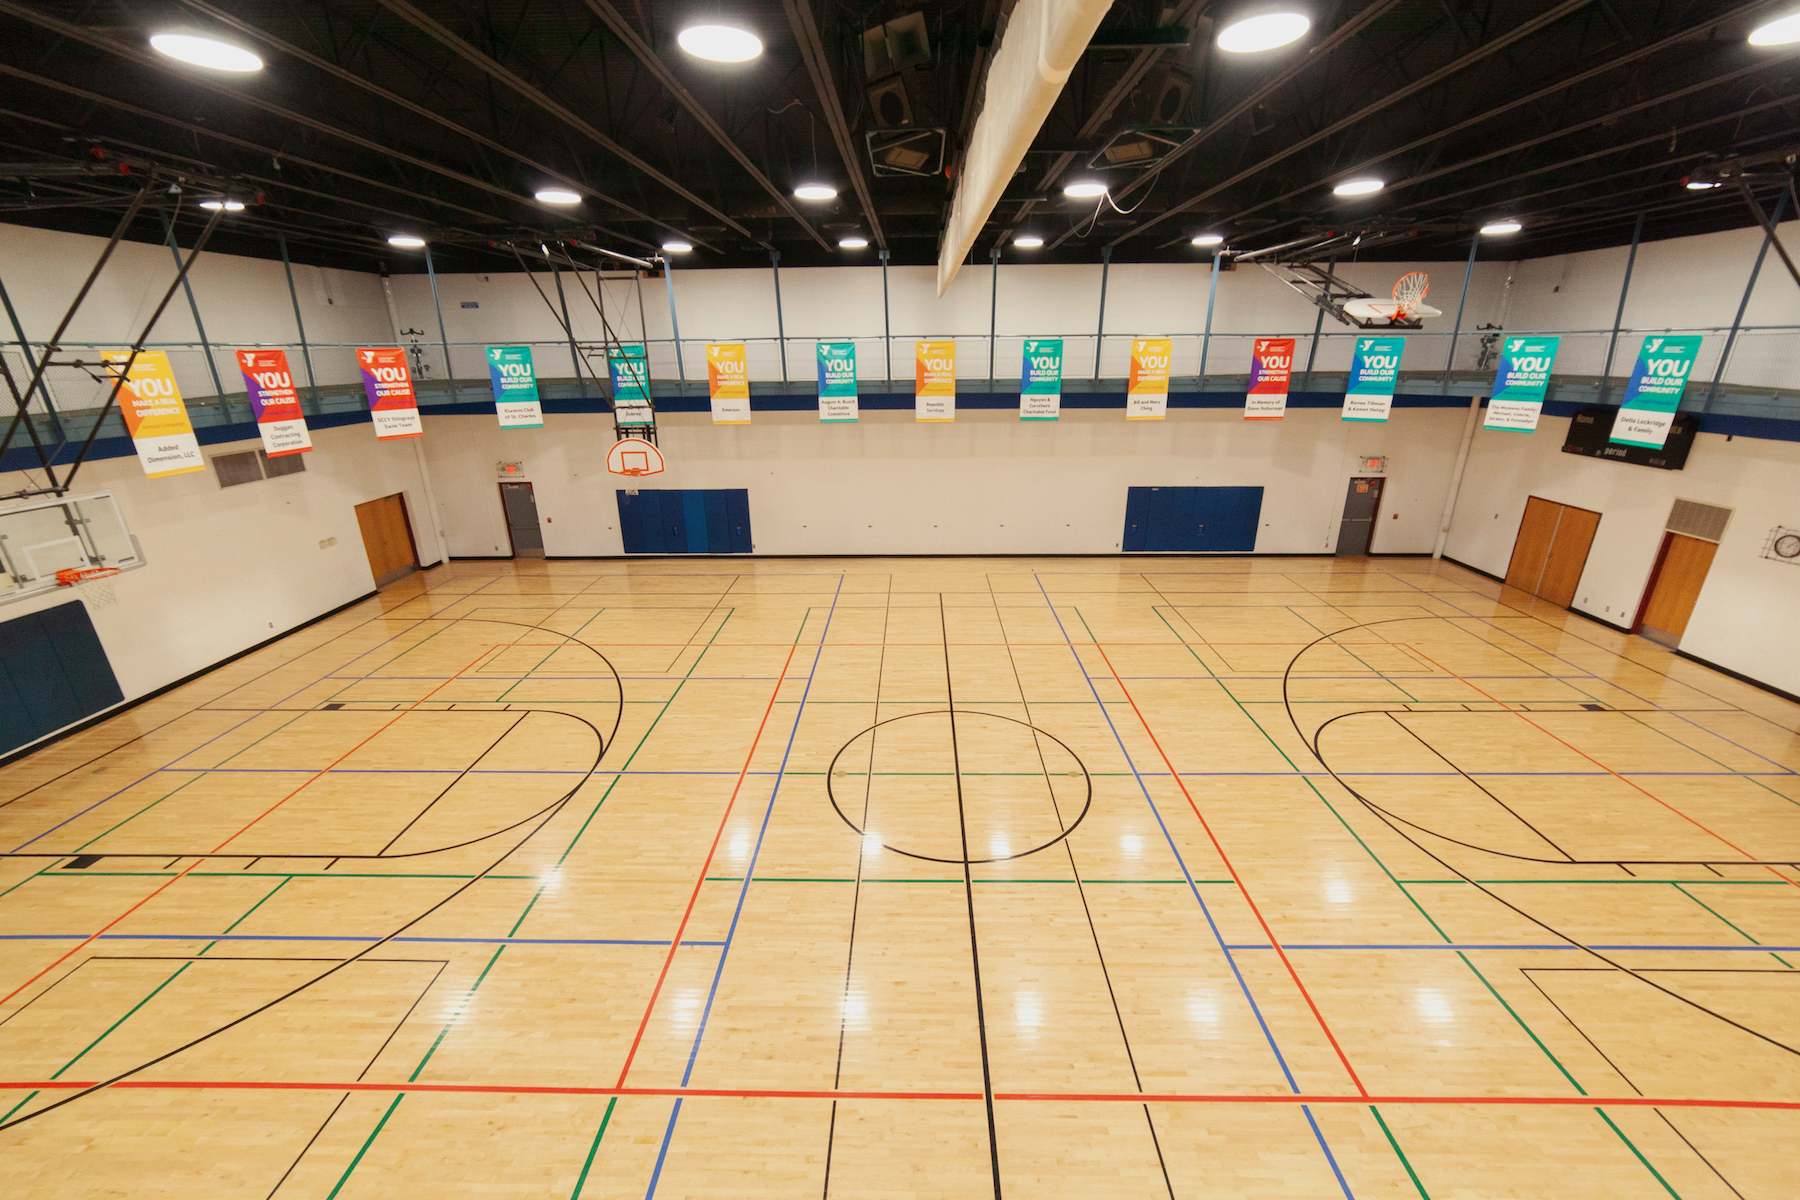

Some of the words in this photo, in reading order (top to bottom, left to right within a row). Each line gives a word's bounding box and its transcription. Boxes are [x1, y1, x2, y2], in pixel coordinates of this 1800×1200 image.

[615, 362, 644, 375] YOU
[716, 361, 744, 373] YOU
[825, 359, 854, 372] YOU
[924, 358, 952, 371] YOU
[1031, 356, 1060, 369] YOU
[1139, 356, 1168, 368] YOU
[1261, 356, 1290, 369] YOU
[1363, 355, 1398, 369] YOU
[1511, 357, 1551, 372] YOU
[1647, 359, 1690, 377] YOU
[370, 367, 406, 382] YOU
[498, 364, 531, 377] YOU
[253, 372, 290, 389] YOU
[1640, 376, 1664, 386] BUILD
[1664, 378, 1684, 386] OUR
[125, 378, 174, 397] YOU
[258, 389, 294, 397] STRENGTHEN
[1638, 385, 1681, 394] COMMUNITY
[260, 398, 275, 406] OUR
[276, 397, 296, 405] CAUSE
[136, 407, 181, 417] DIFFERENCE
[1637, 418, 1667, 427] Lockridge
[1634, 426, 1653, 435] Family
[147, 454, 183, 463] Dimension,
[1604, 447, 1628, 457] period
